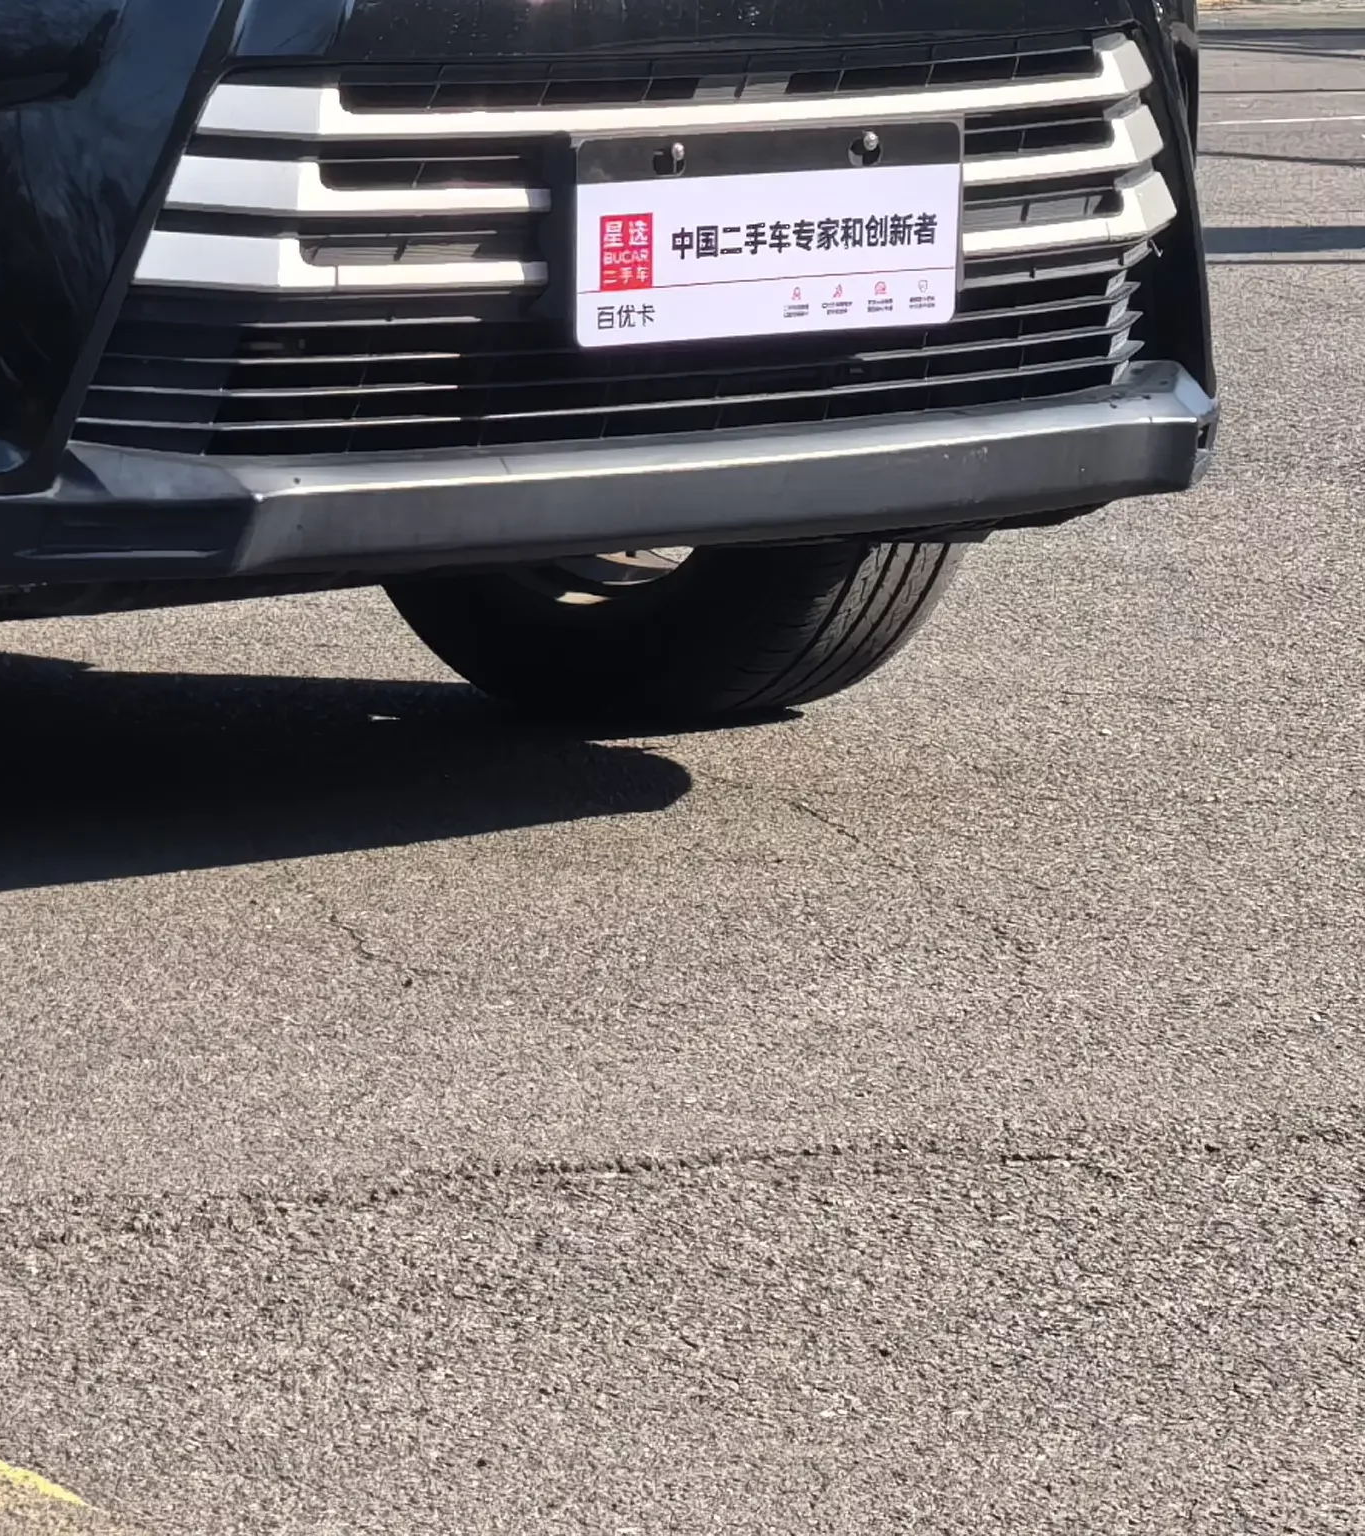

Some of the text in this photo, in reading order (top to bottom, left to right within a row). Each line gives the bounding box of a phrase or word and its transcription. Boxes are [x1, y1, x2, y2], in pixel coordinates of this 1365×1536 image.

[603, 220, 649, 248] 星选
[671, 213, 938, 260] 中国二手车专家和创新者
[603, 249, 649, 265] BUCAR
[603, 266, 649, 284] 二手车
[597, 303, 655, 330] 百优卡
